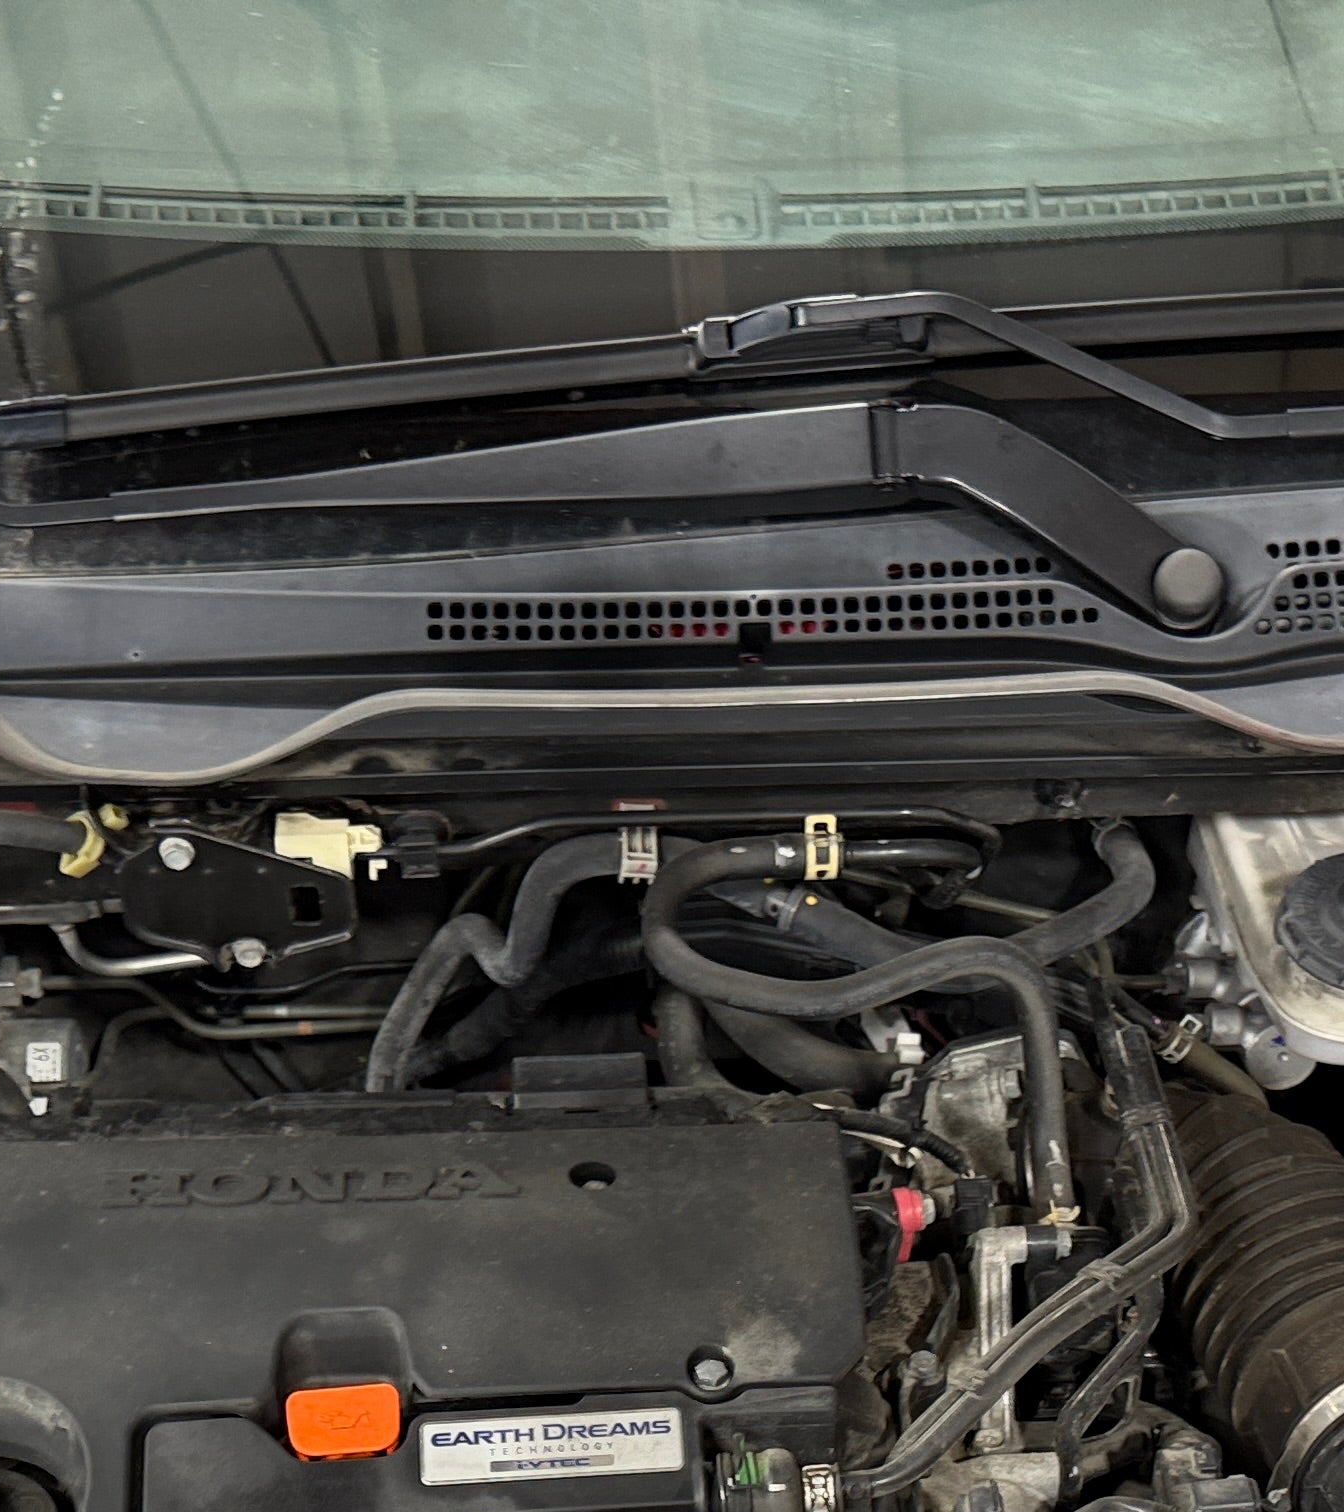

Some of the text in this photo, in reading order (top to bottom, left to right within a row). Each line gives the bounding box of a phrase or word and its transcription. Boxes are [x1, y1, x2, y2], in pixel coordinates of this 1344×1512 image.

[102, 1162, 522, 1208] HONDA
[431, 1419, 672, 1447] EARTH DREAMS
[489, 1441, 615, 1456] TECHNOLOGY
